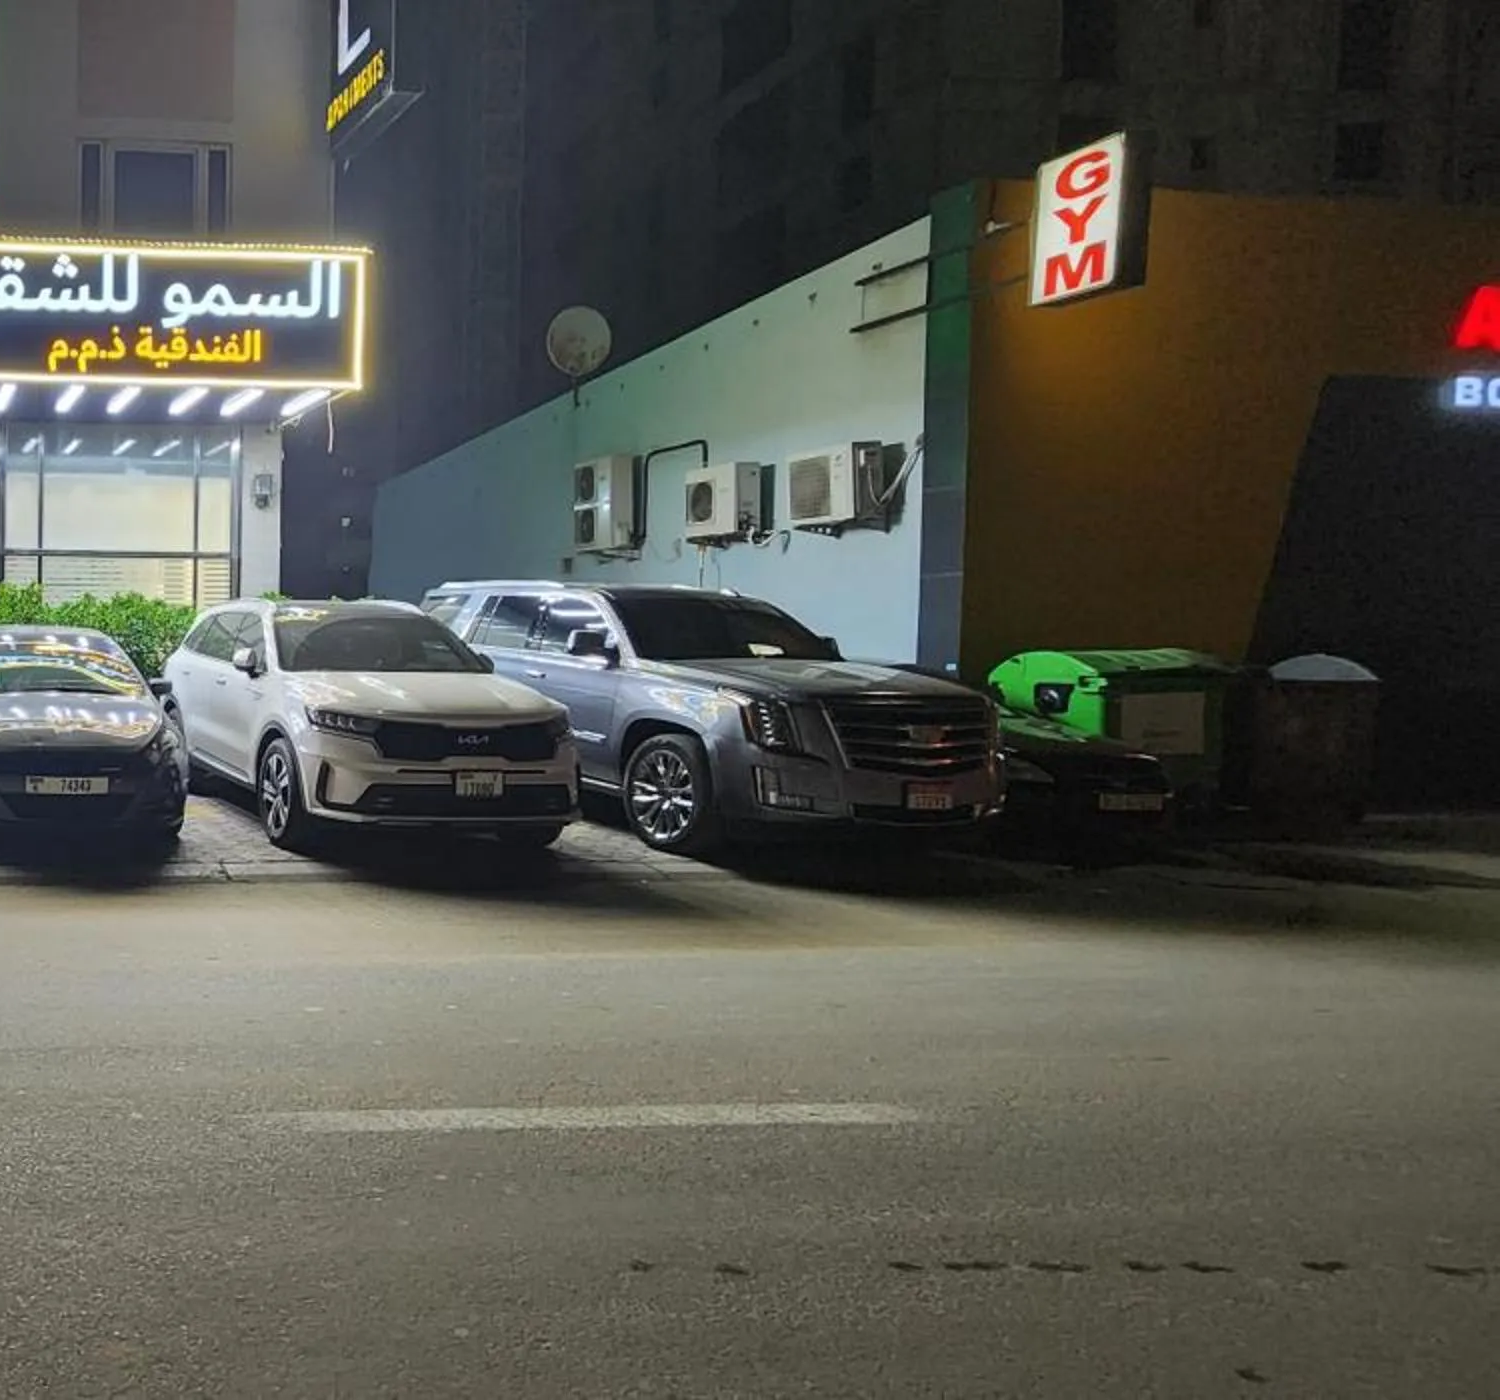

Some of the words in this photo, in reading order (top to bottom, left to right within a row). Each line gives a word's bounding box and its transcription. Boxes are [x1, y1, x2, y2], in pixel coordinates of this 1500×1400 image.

[1043, 151, 1111, 297] GYM
[161, 255, 341, 327] السمو
[134, 327, 262, 368] الفندقية
